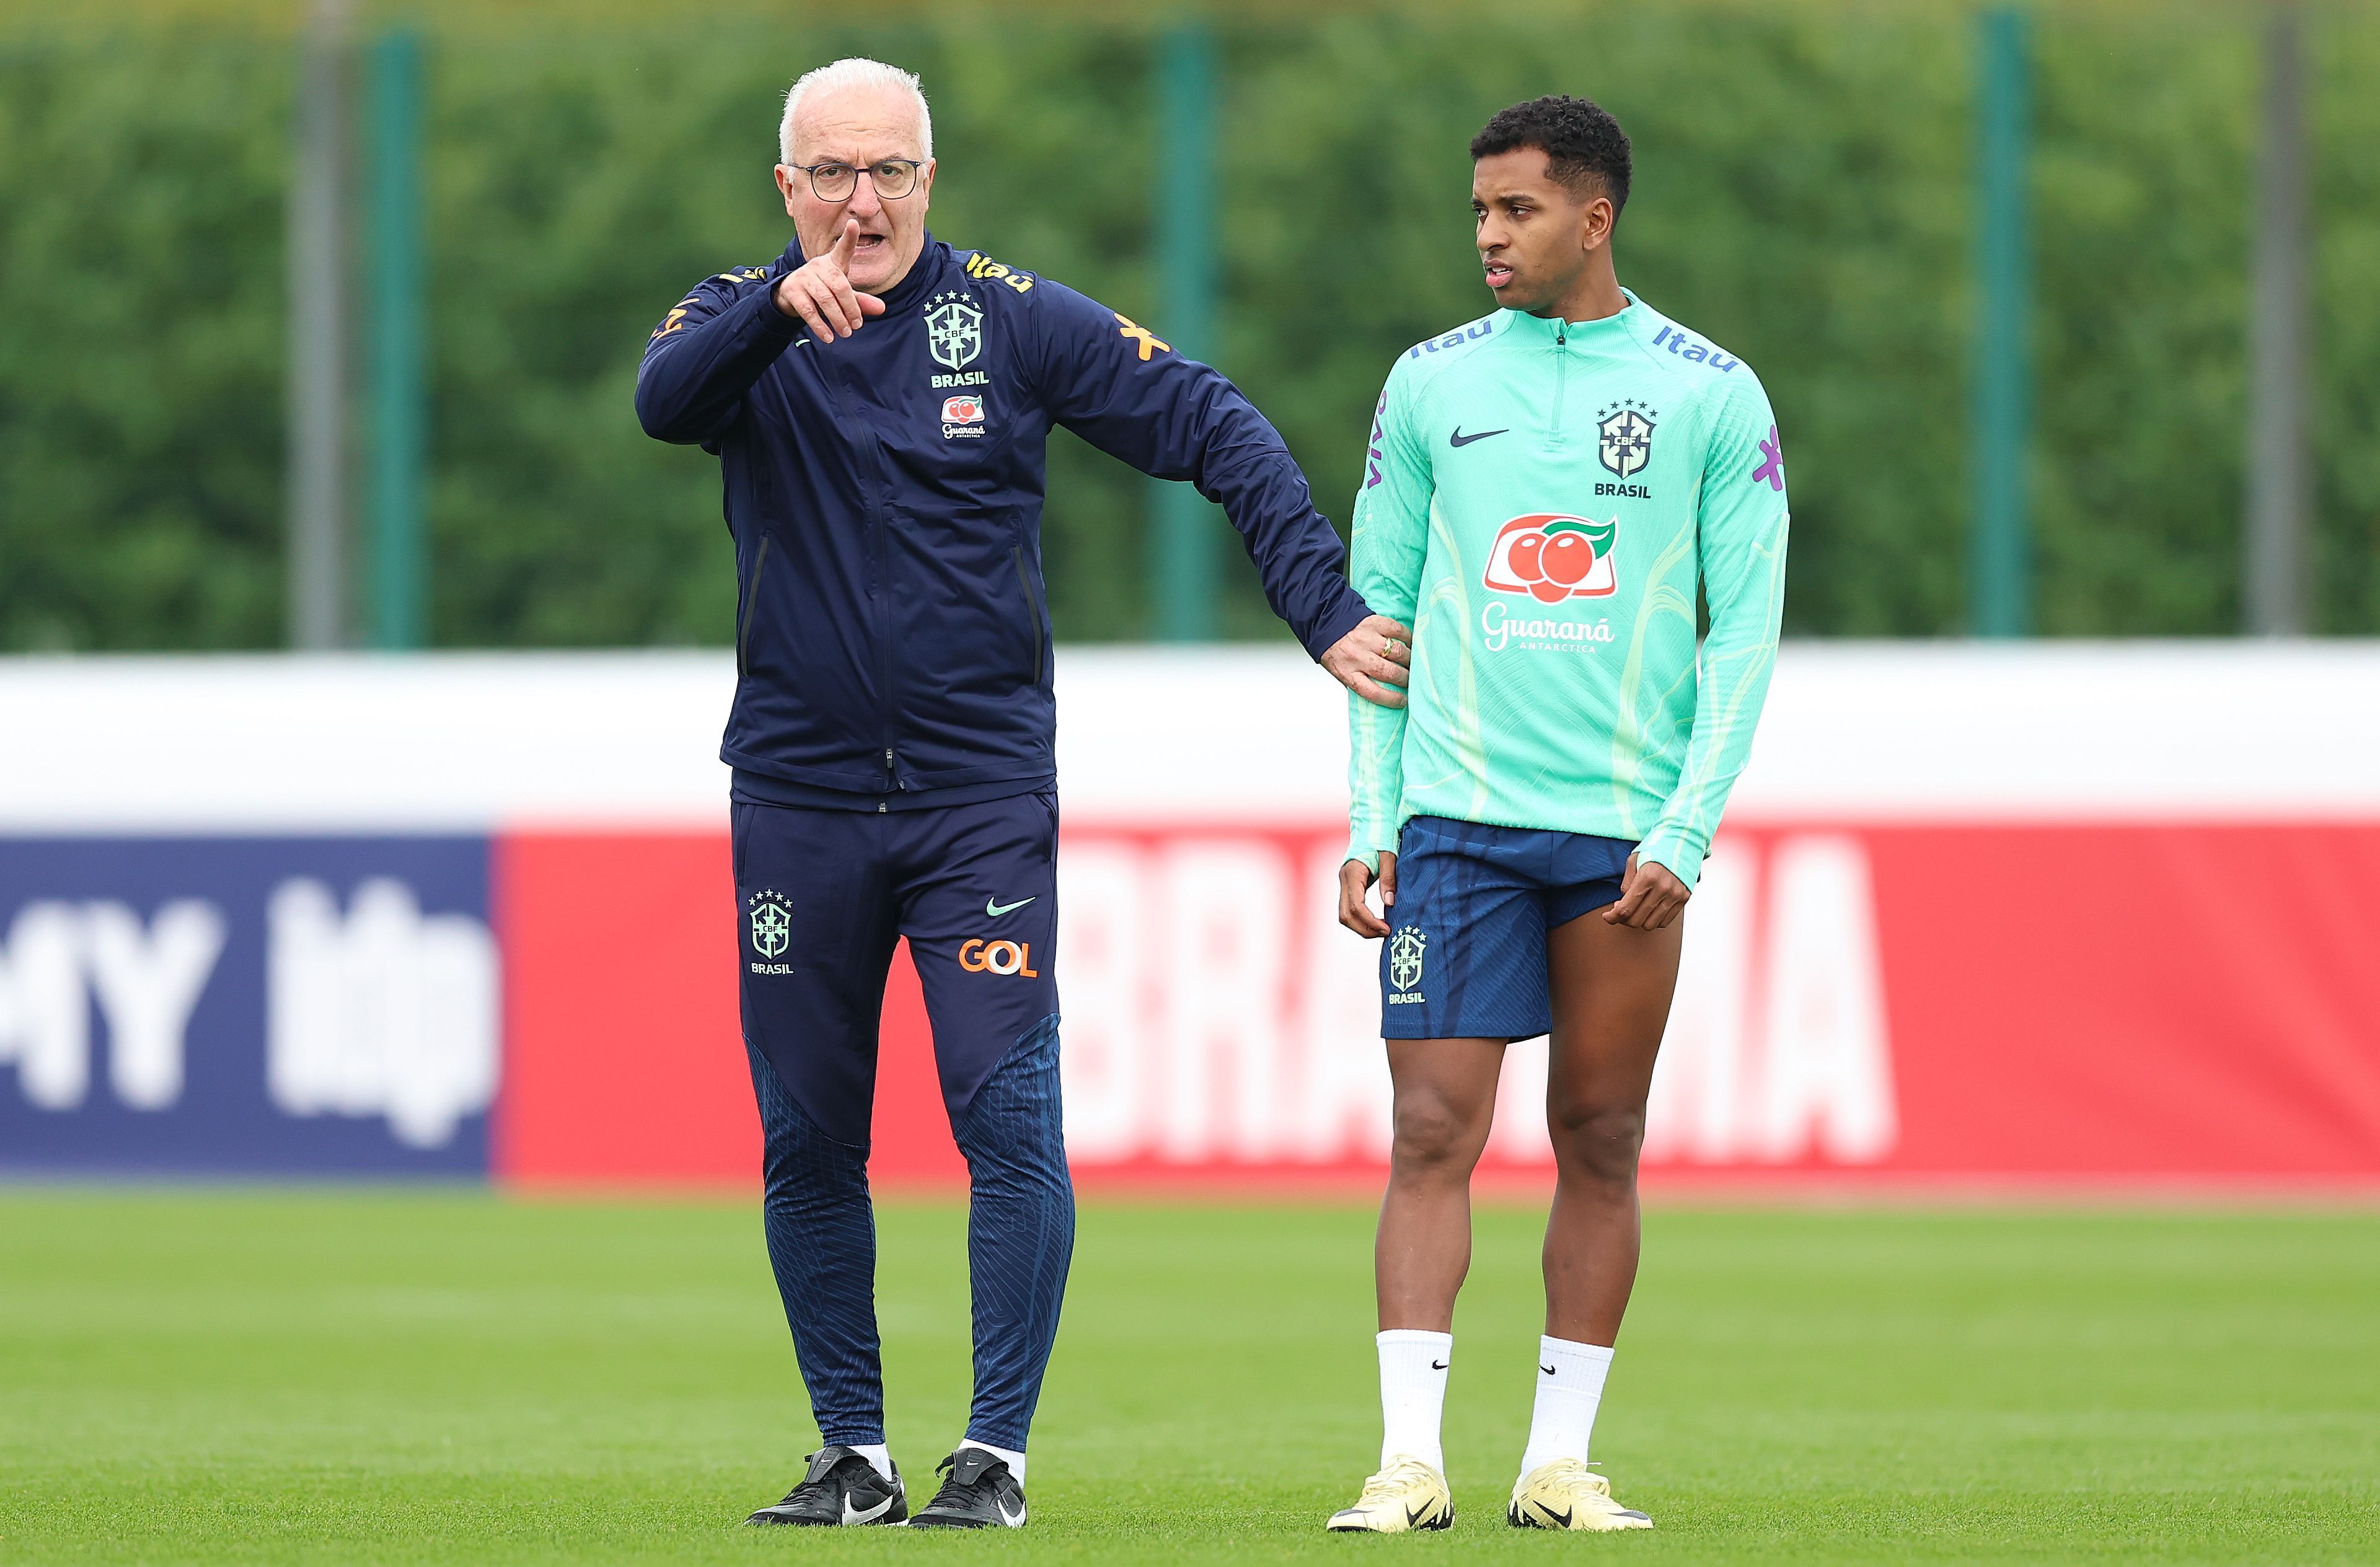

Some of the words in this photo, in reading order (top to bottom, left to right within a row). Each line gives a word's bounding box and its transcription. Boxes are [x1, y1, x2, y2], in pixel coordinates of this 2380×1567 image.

[966, 252, 1034, 294] Itaú
[945, 329, 965, 338] CBF
[1652, 325, 1739, 373] Itaú
[930, 371, 990, 388] BRASIL
[941, 423, 985, 439] Guaraná
[1613, 436, 1637, 446] CBF
[1594, 483, 1652, 499] BRASIL
[1481, 600, 1616, 652] Guaraná
[1519, 641, 1596, 654] ANTARCTICA
[959, 939, 1038, 978] GOL
[751, 962, 794, 975] BRASIL
[1388, 992, 1426, 1004] BRASIL
